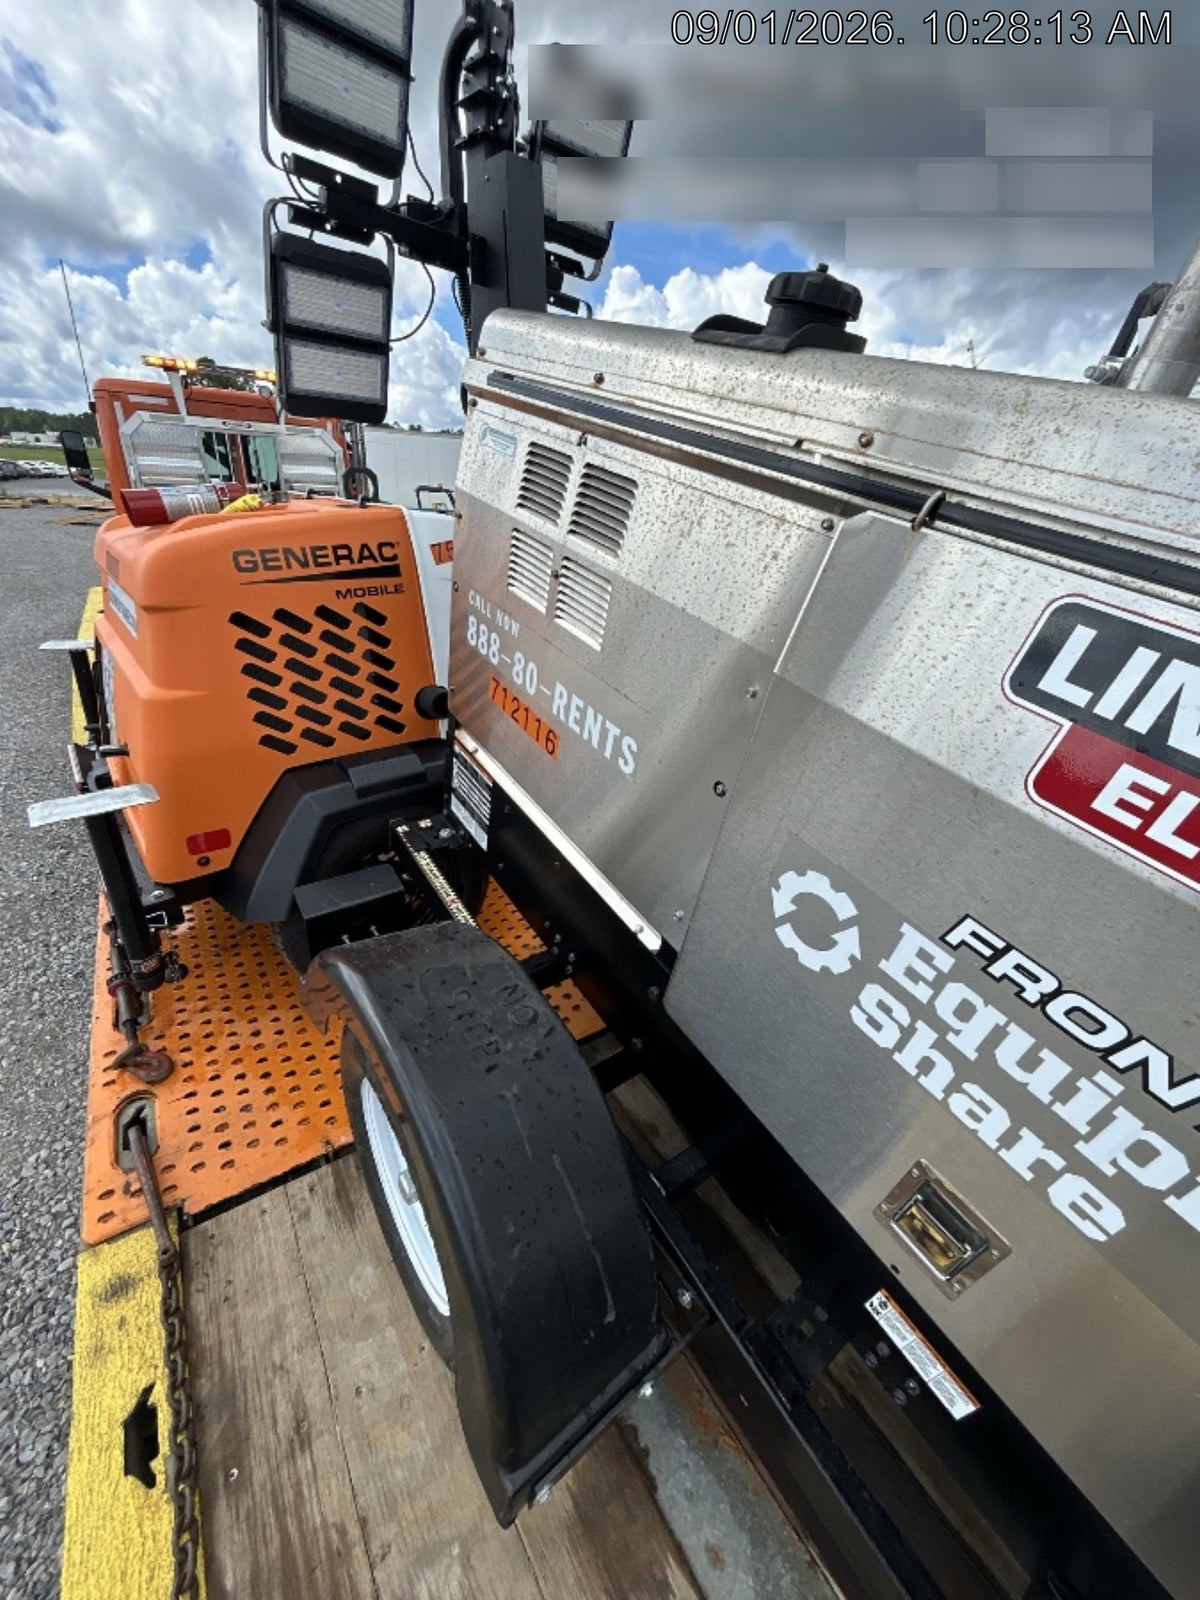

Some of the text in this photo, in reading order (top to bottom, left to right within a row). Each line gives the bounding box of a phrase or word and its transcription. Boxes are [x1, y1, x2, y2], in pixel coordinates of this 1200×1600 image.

[232, 541, 399, 573] GENERAC
[335, 583, 405, 600] MOBILE
[468, 589, 520, 638] CALL NOW
[466, 614, 637, 775] 888-80-RENTS
[491, 675, 559, 756] 712116
[1090, 762, 1200, 860] EL
[850, 983, 1127, 1242] Share
